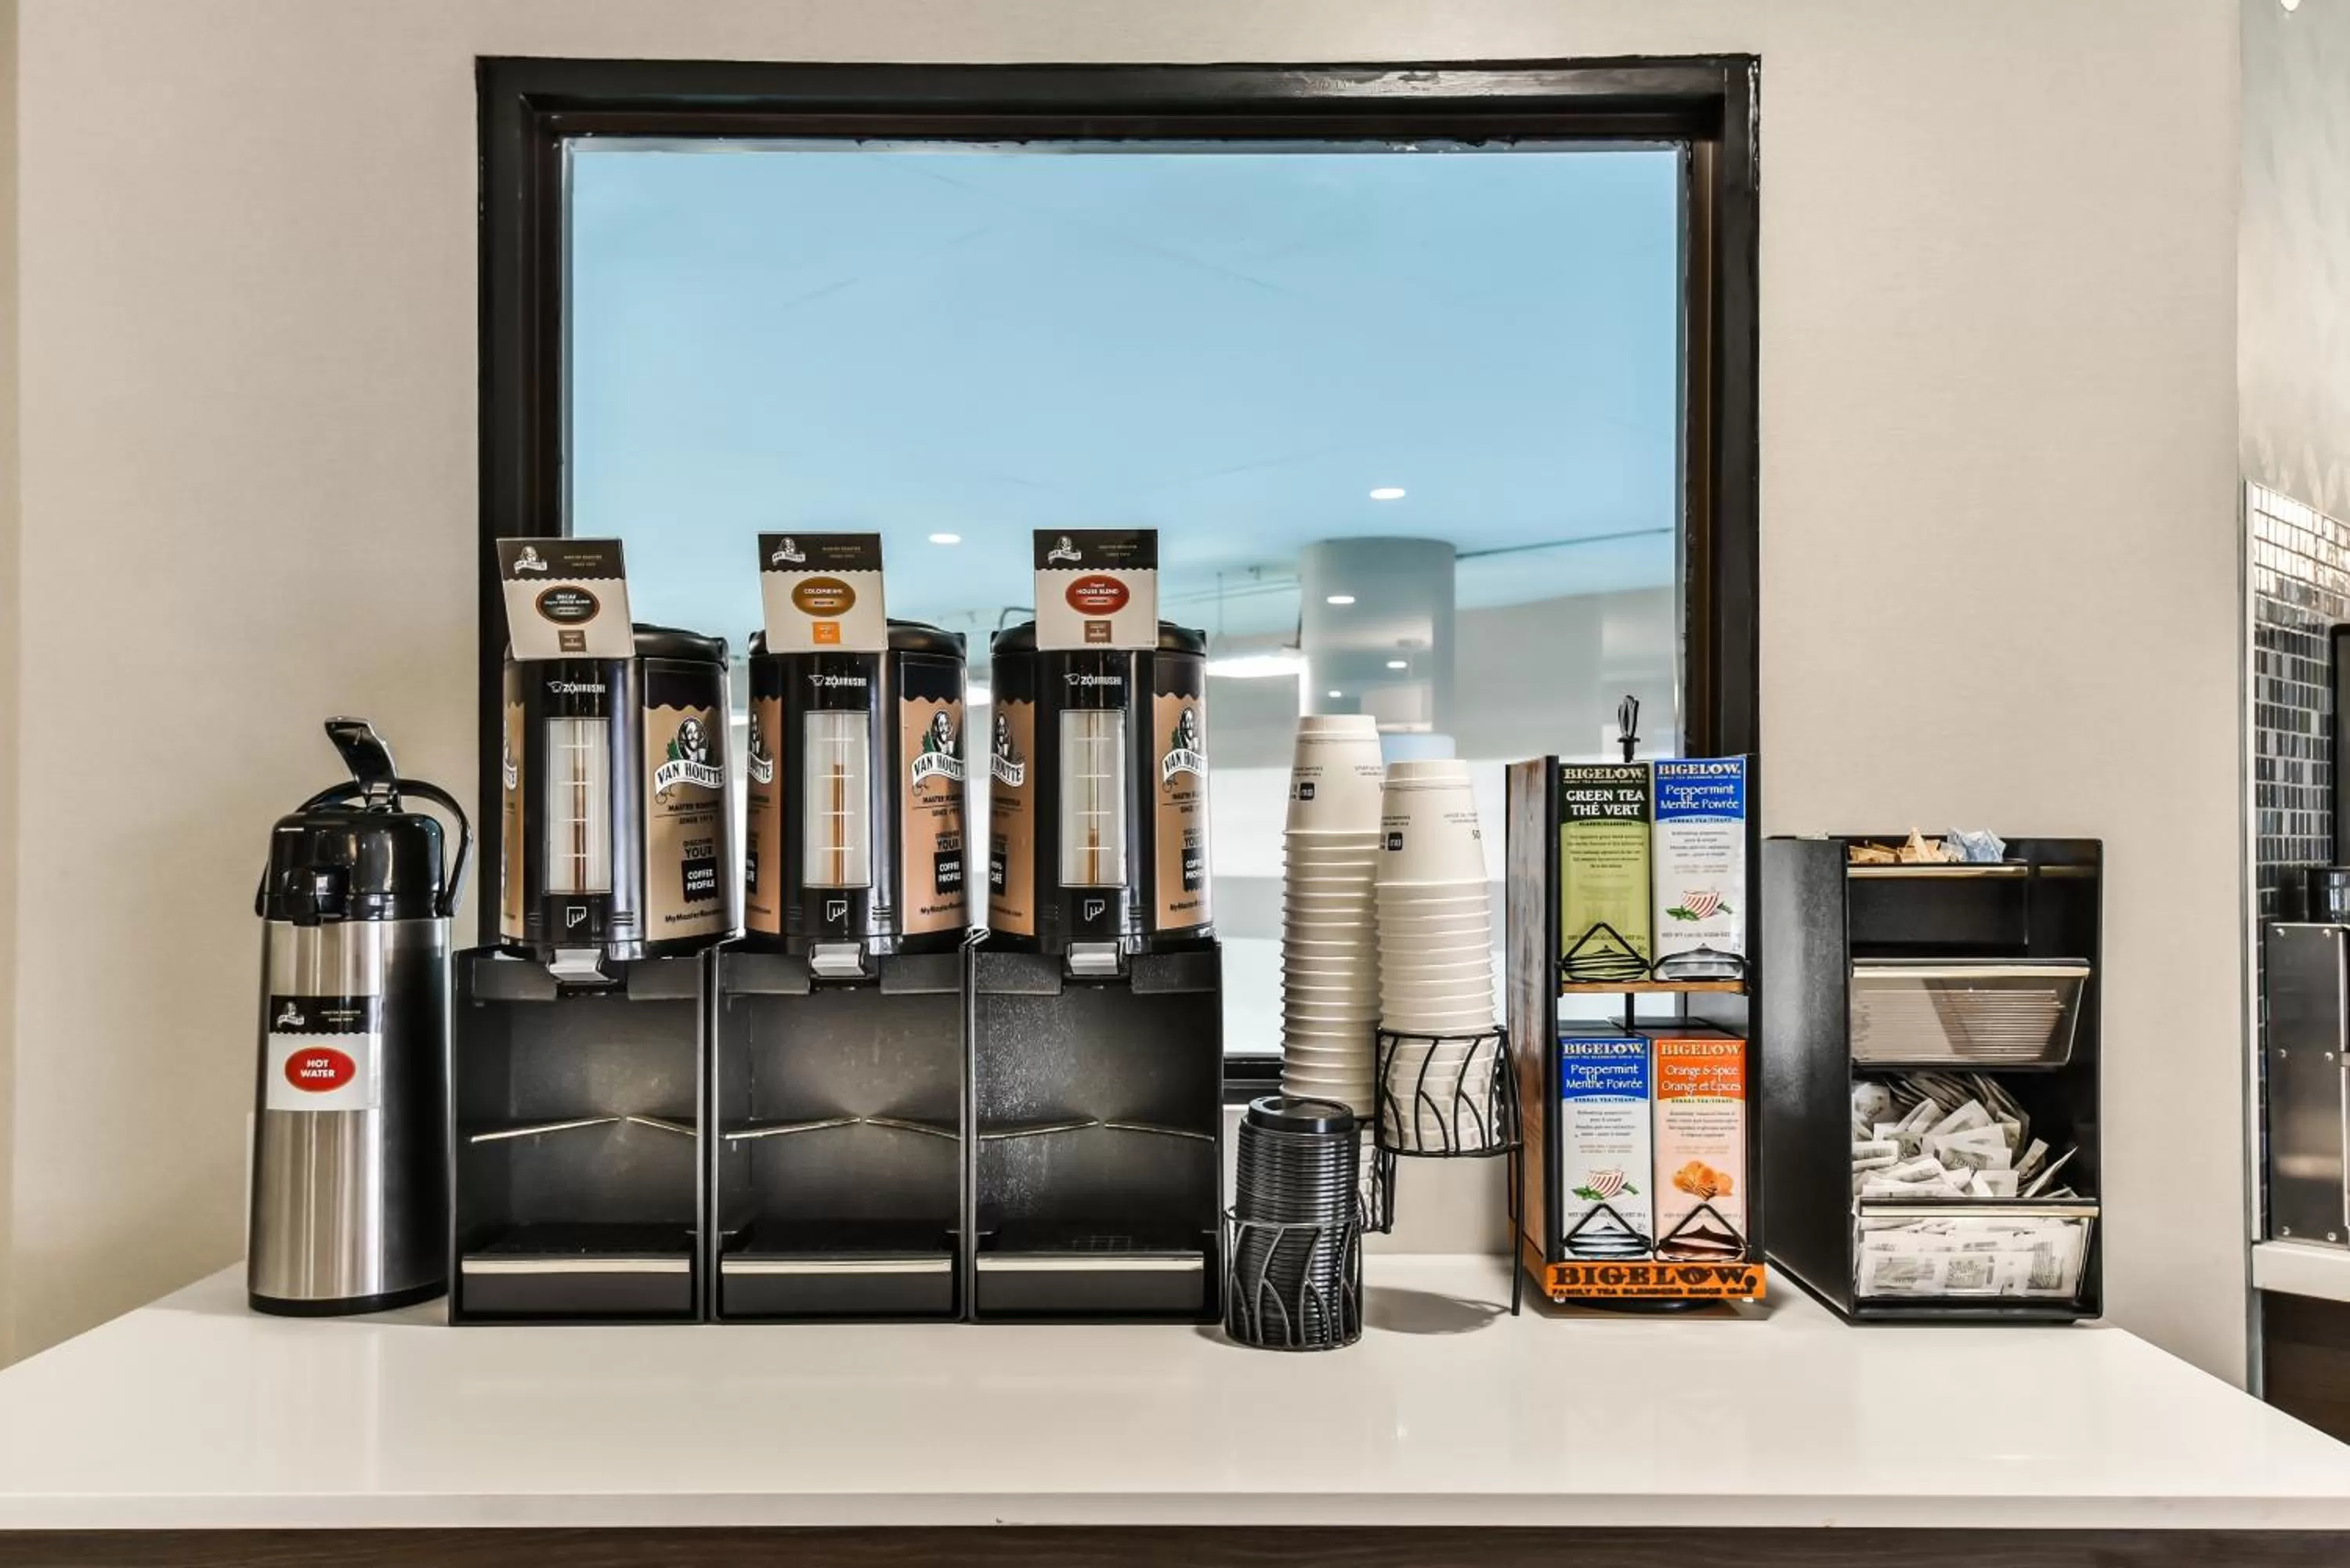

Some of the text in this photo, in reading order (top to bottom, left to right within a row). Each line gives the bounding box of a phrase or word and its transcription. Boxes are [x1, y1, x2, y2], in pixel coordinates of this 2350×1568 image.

[914, 755, 933, 776] VAN
[1658, 764, 1741, 775] BIGELOW
[657, 763, 681, 785] VAN
[685, 762, 725, 784] HOUTTE
[1564, 768, 1644, 779] BIGELOW
[1566, 789, 1645, 801] GREEN TEA
[1666, 783, 1734, 800] Peppermint
[1571, 801, 1641, 815] THÉ VERT
[1661, 794, 1739, 809] Menthe Poivrée
[1564, 1042, 1644, 1055] BIGELOW
[1661, 1044, 1741, 1055] BIGELOW
[306, 1059, 329, 1068] HOT
[300, 1069, 336, 1078] WATER
[1571, 1063, 1640, 1081] Peppermint
[1665, 1065, 1701, 1081] Orange
[1567, 1074, 1643, 1089] Menthe Poivrée
[1661, 1080, 1697, 1097] Orange
[1553, 1266, 1752, 1285] BIGELOW
